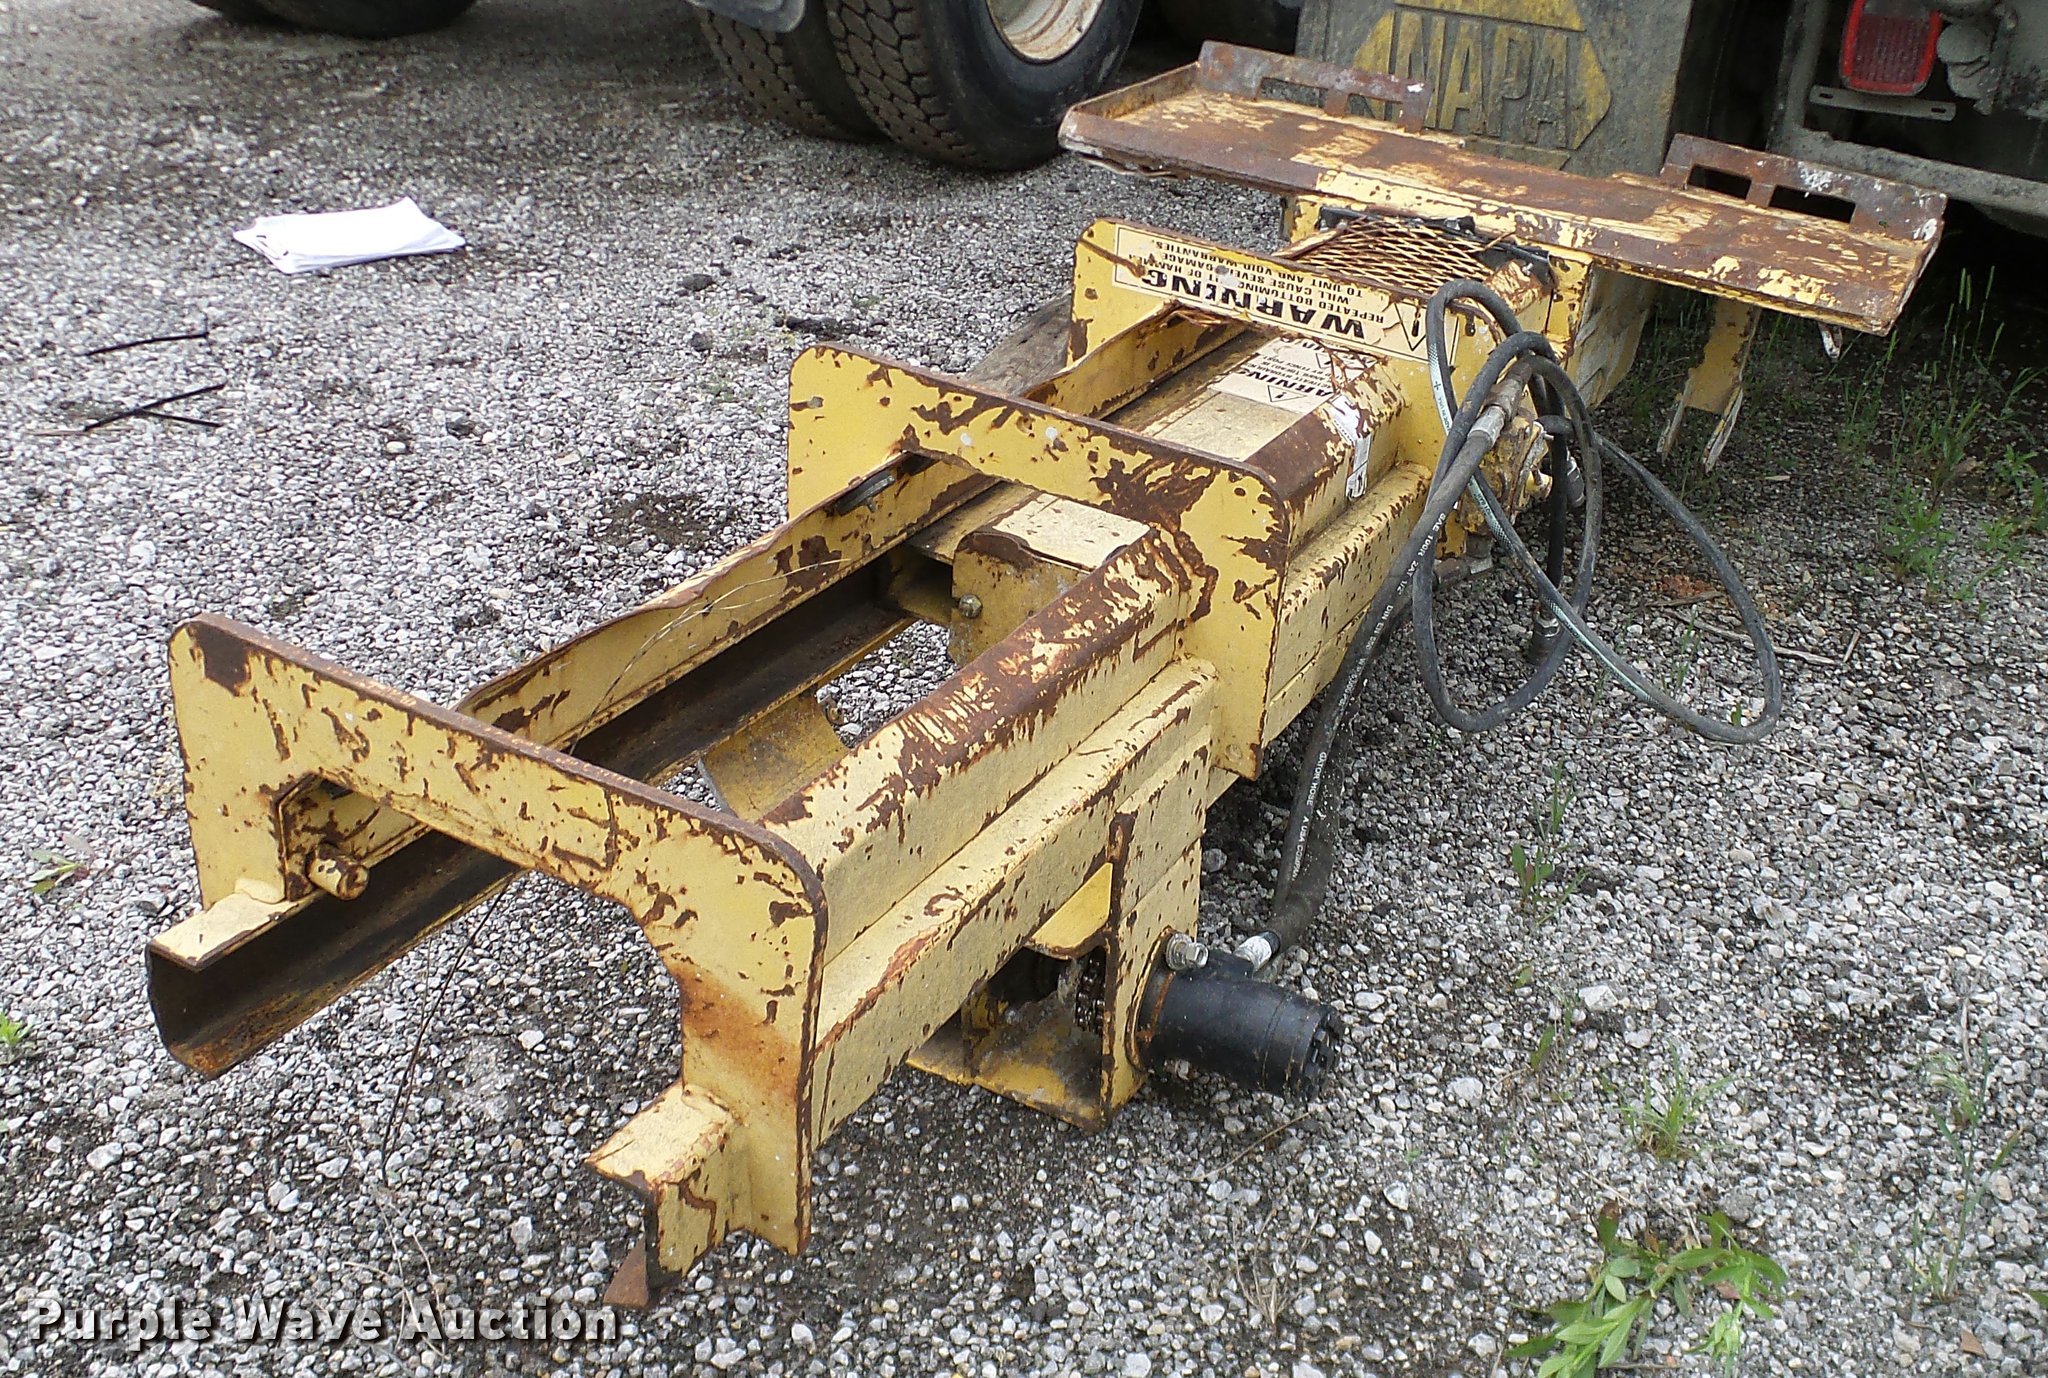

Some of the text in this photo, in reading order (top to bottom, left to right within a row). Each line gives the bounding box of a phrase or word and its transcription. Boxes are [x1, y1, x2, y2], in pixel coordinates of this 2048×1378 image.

[1396, 10, 1568, 149] NAPA
[1160, 252, 1213, 271] DAMAGE
[1242, 262, 1272, 275] VOID
[1277, 271, 1304, 283] AND
[1309, 278, 1341, 292] UNIT
[1269, 278, 1312, 295] CAUSE
[1345, 286, 1362, 297] TO
[1141, 268, 1364, 339] WARNING
[1317, 289, 1348, 304] WILL
[1317, 300, 1383, 324] REPEATED
[1236, 368, 1332, 396] ARNING
[1432, 512, 1446, 532] SAE
[1417, 535, 1434, 557] 100R
[1381, 604, 1394, 620] DIN
[1313, 751, 1327, 780] GATOR
[1306, 782, 1319, 806] HOSE
[1302, 815, 1310, 823] A
[1298, 825, 1308, 842] USA
